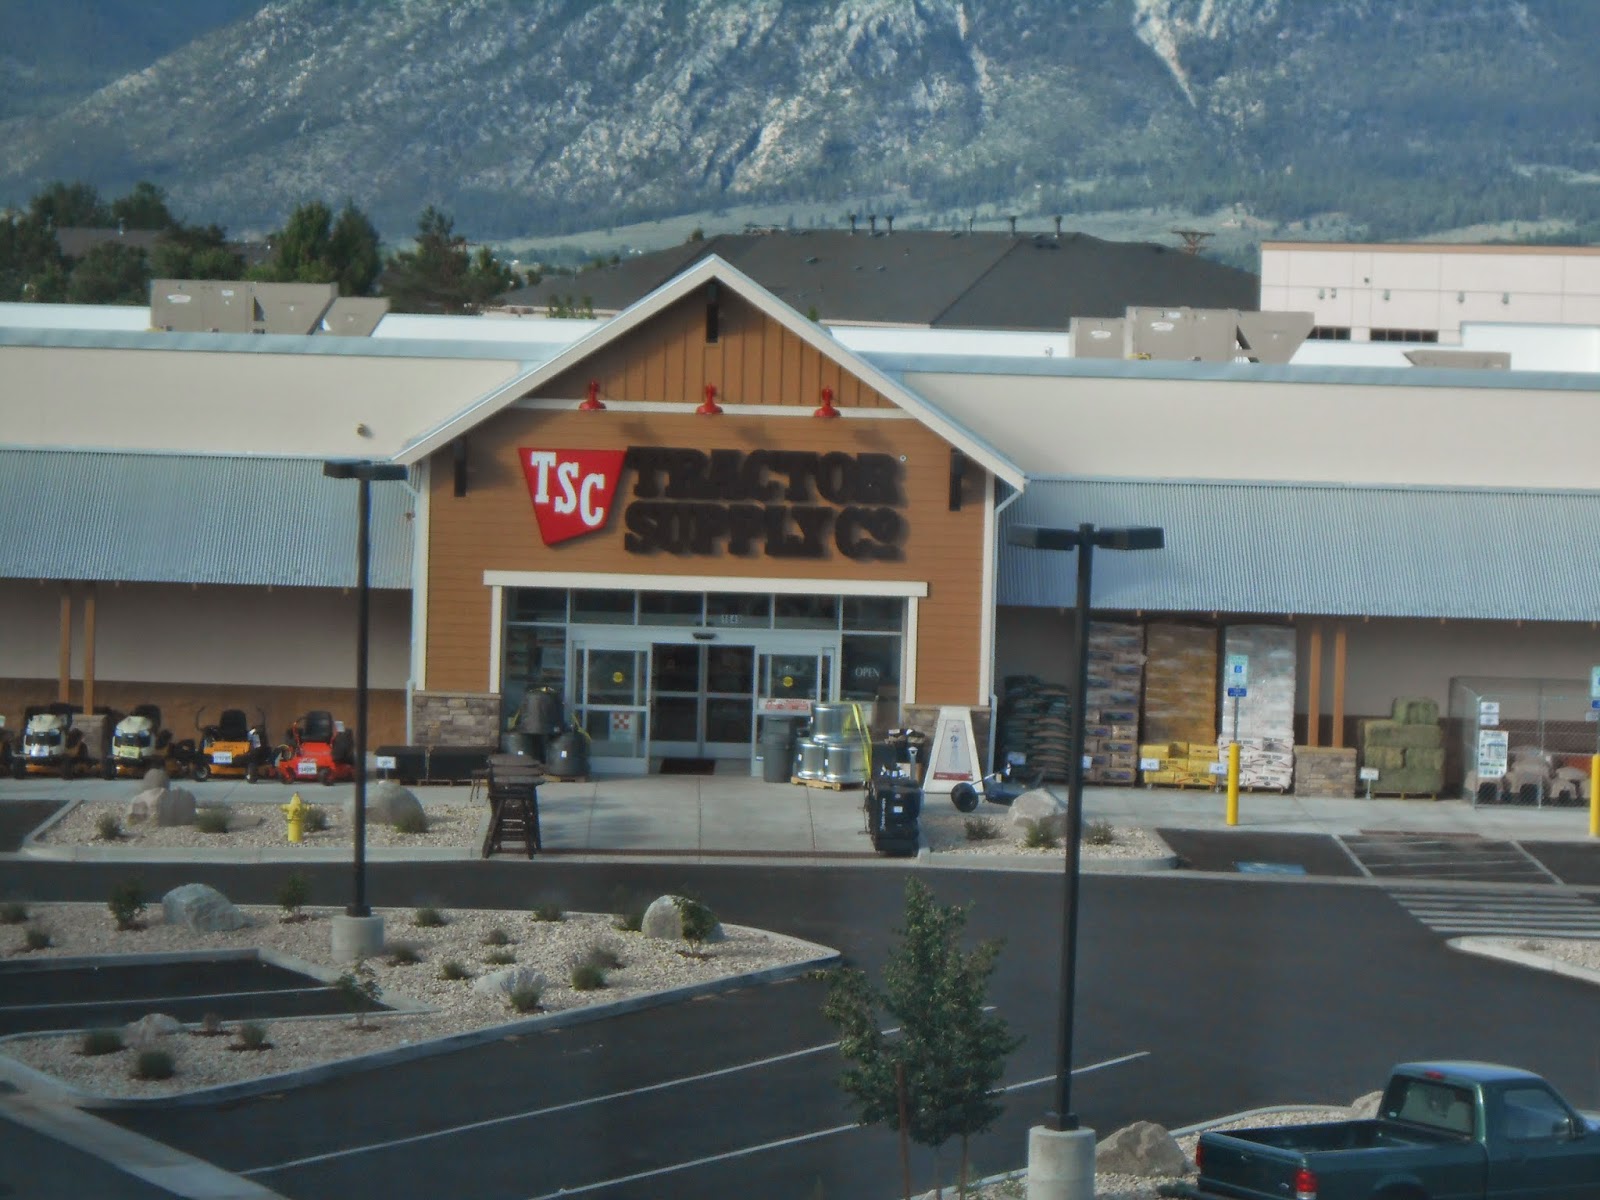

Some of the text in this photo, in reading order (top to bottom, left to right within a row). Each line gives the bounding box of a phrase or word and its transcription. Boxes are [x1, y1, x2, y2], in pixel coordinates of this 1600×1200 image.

[531, 451, 605, 527] TSC
[628, 447, 902, 505] TRACTOR
[625, 502, 831, 557] SUPPLY
[855, 667, 881, 679] OPEN
